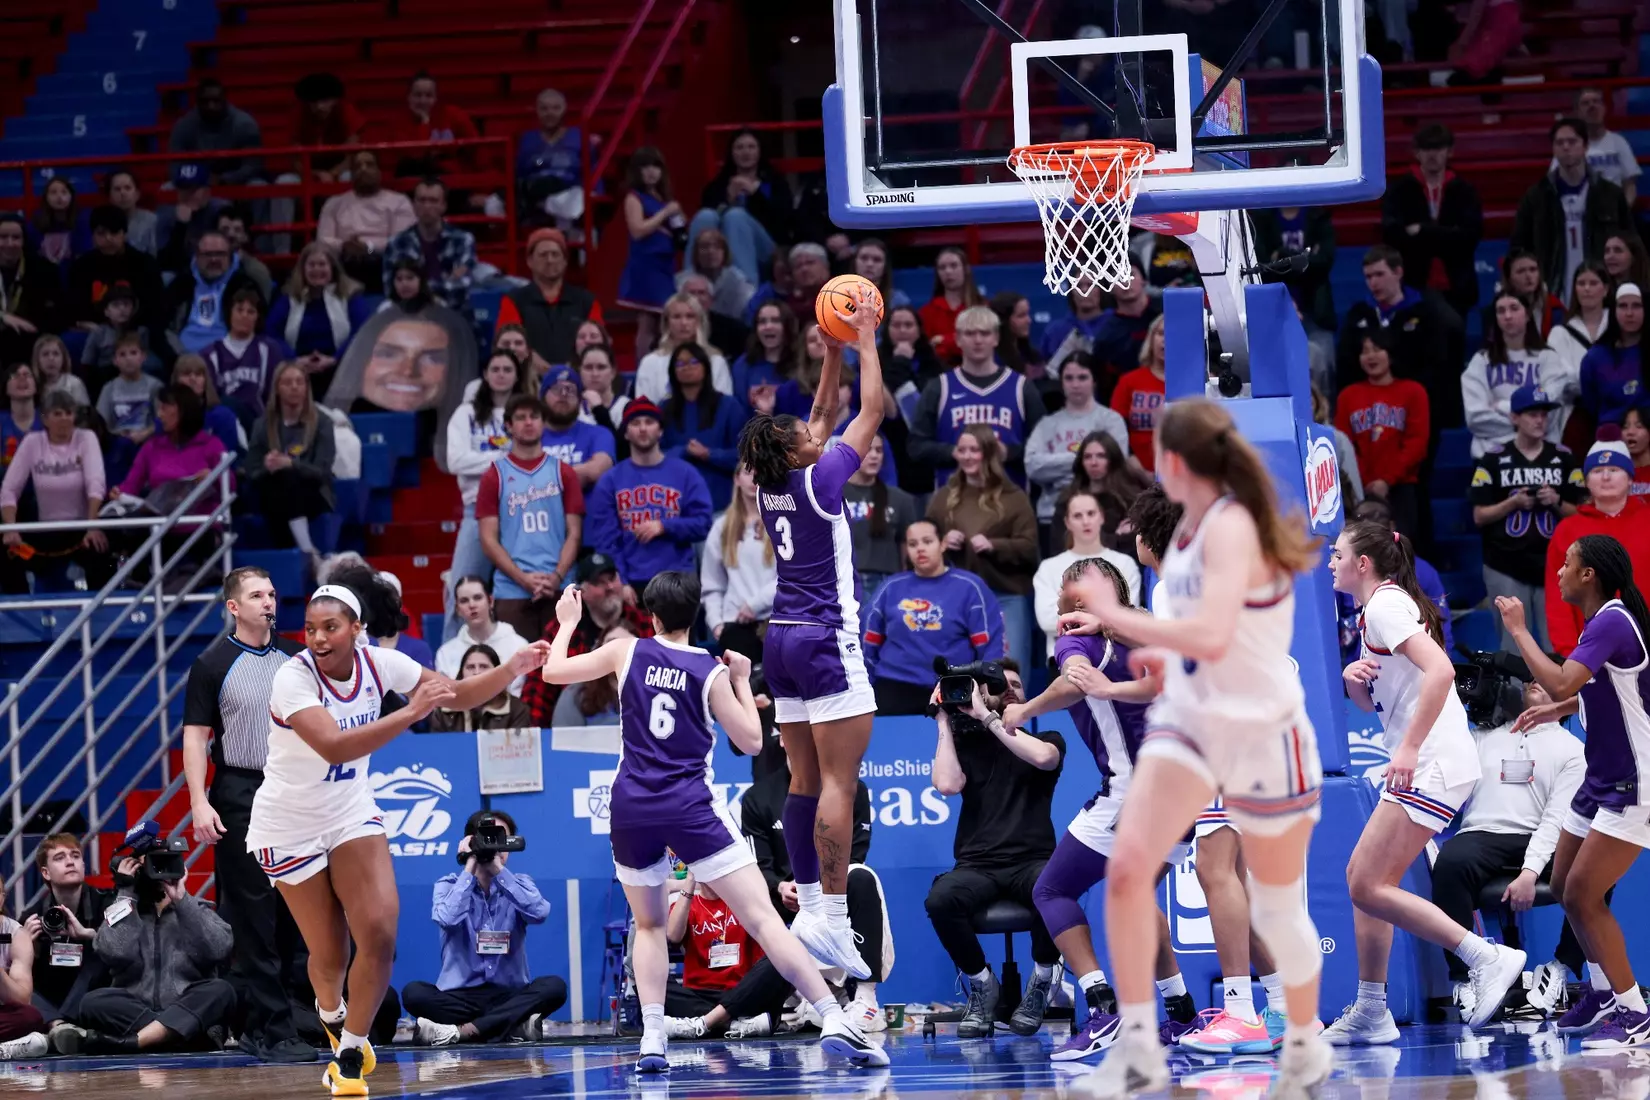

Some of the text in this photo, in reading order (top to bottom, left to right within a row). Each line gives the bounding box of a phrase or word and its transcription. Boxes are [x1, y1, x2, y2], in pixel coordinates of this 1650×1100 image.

[132, 30, 146, 51] 7
[102, 72, 117, 94] 6
[73, 115, 87, 137] 5
[866, 192, 915, 206] SPALDING
[951, 405, 1012, 429] PHILA
[1500, 468, 1562, 487] KANSAS
[616, 484, 681, 513] ROCK
[762, 493, 796, 511] HARROD
[523, 511, 549, 533] 00
[774, 516, 794, 561] 3
[645, 665, 687, 691] GARCIA
[649, 692, 677, 740] 6
[389, 841, 449, 857] ASH
